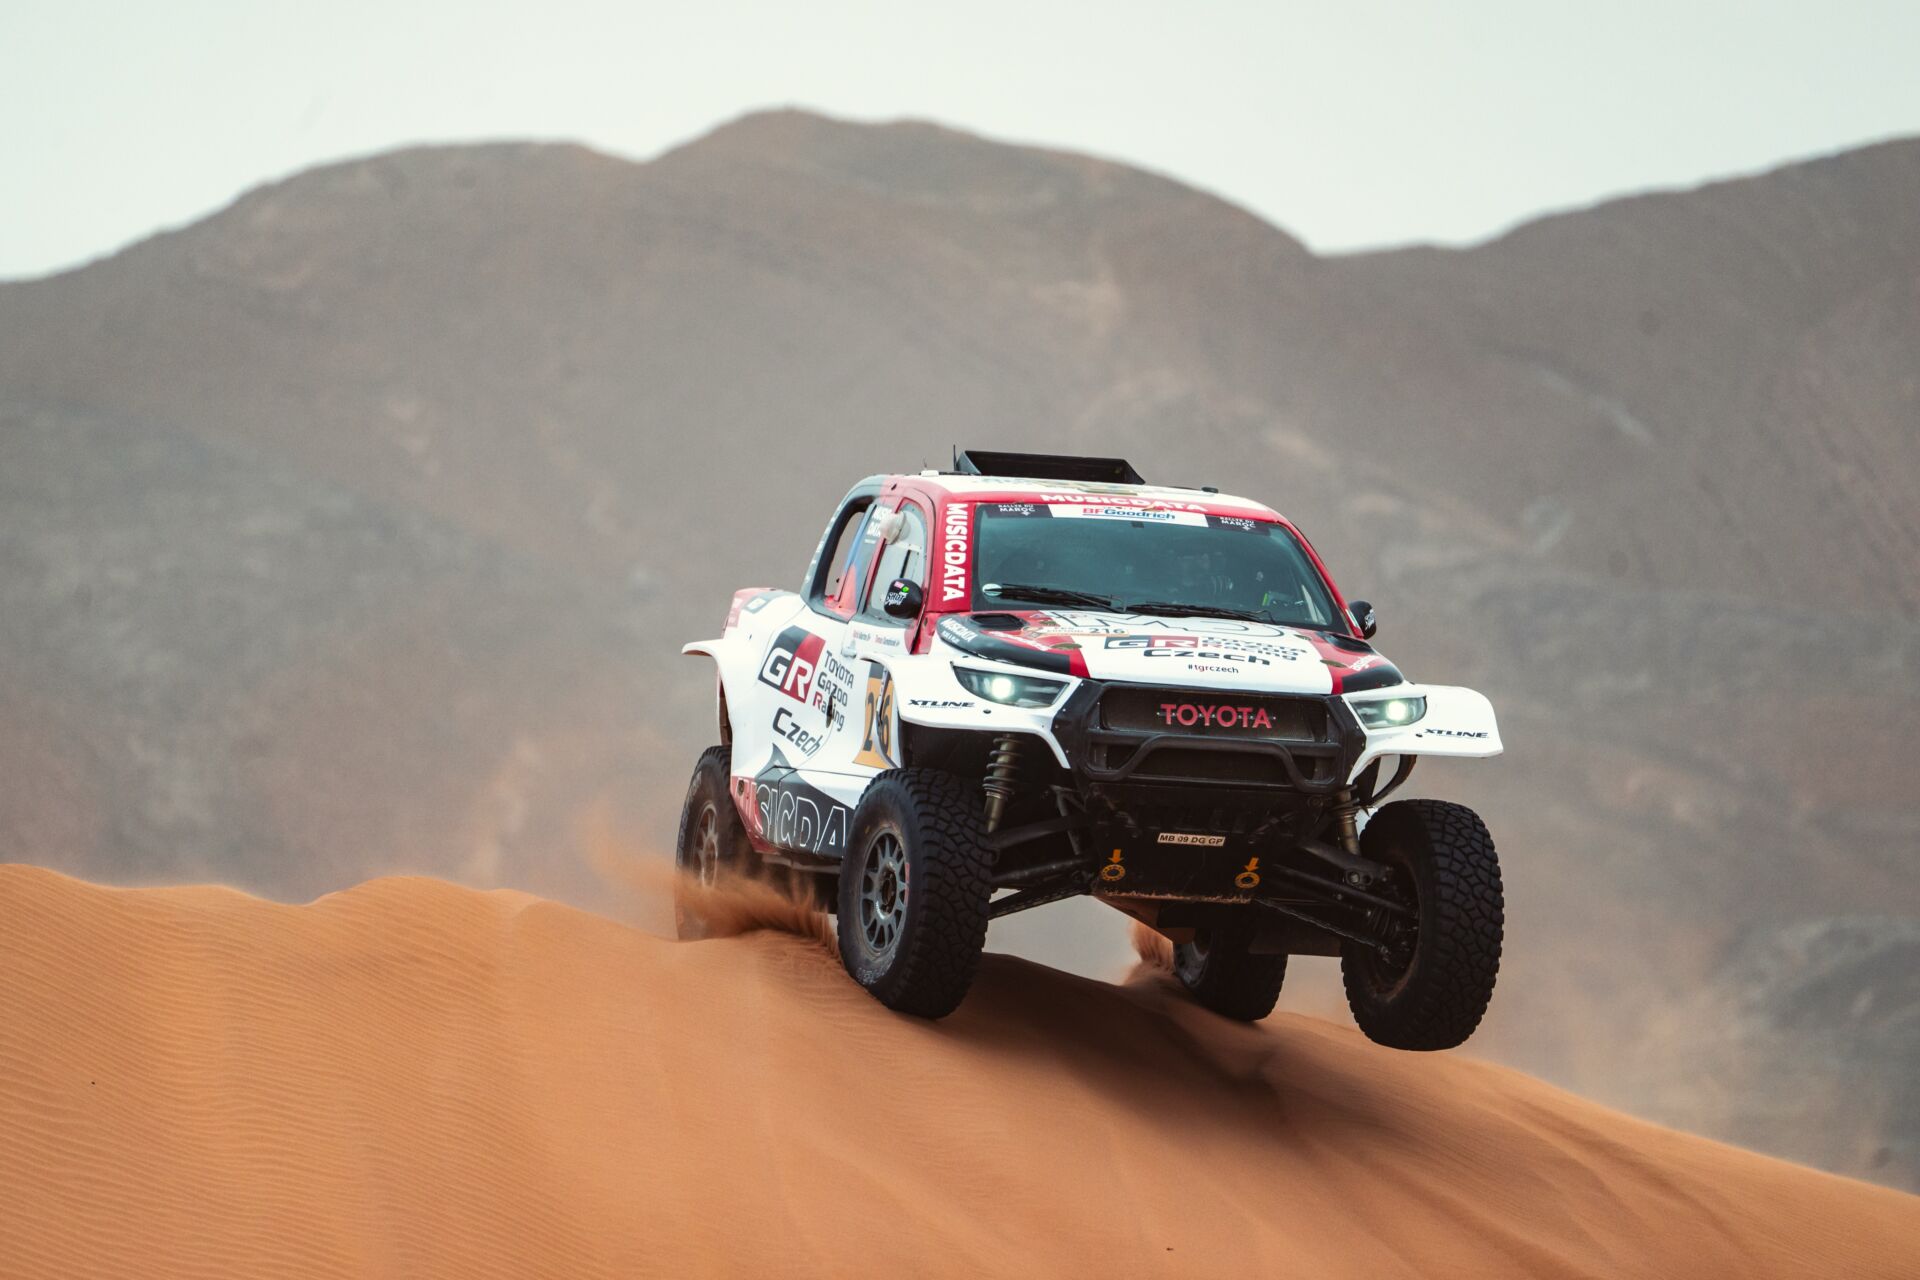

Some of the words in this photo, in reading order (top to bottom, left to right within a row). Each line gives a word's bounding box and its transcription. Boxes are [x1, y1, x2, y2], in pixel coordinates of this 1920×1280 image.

[1039, 494, 1209, 512] MUSICDATA
[1083, 507, 1175, 519] BFGoodrich
[943, 503, 968, 602] MUSICDATA
[1106, 637, 1197, 649] GR
[1143, 649, 1270, 665] Czech
[762, 647, 814, 700] GR
[825, 650, 854, 688] TOYOTA
[1188, 663, 1239, 674] #tgrczech
[818, 672, 848, 707] GAZOO
[812, 691, 845, 732] Raing
[908, 699, 975, 708] XTLINE
[1161, 704, 1272, 728] TOYOTA
[772, 707, 823, 756] Czech
[1424, 728, 1488, 738] XTLINE
